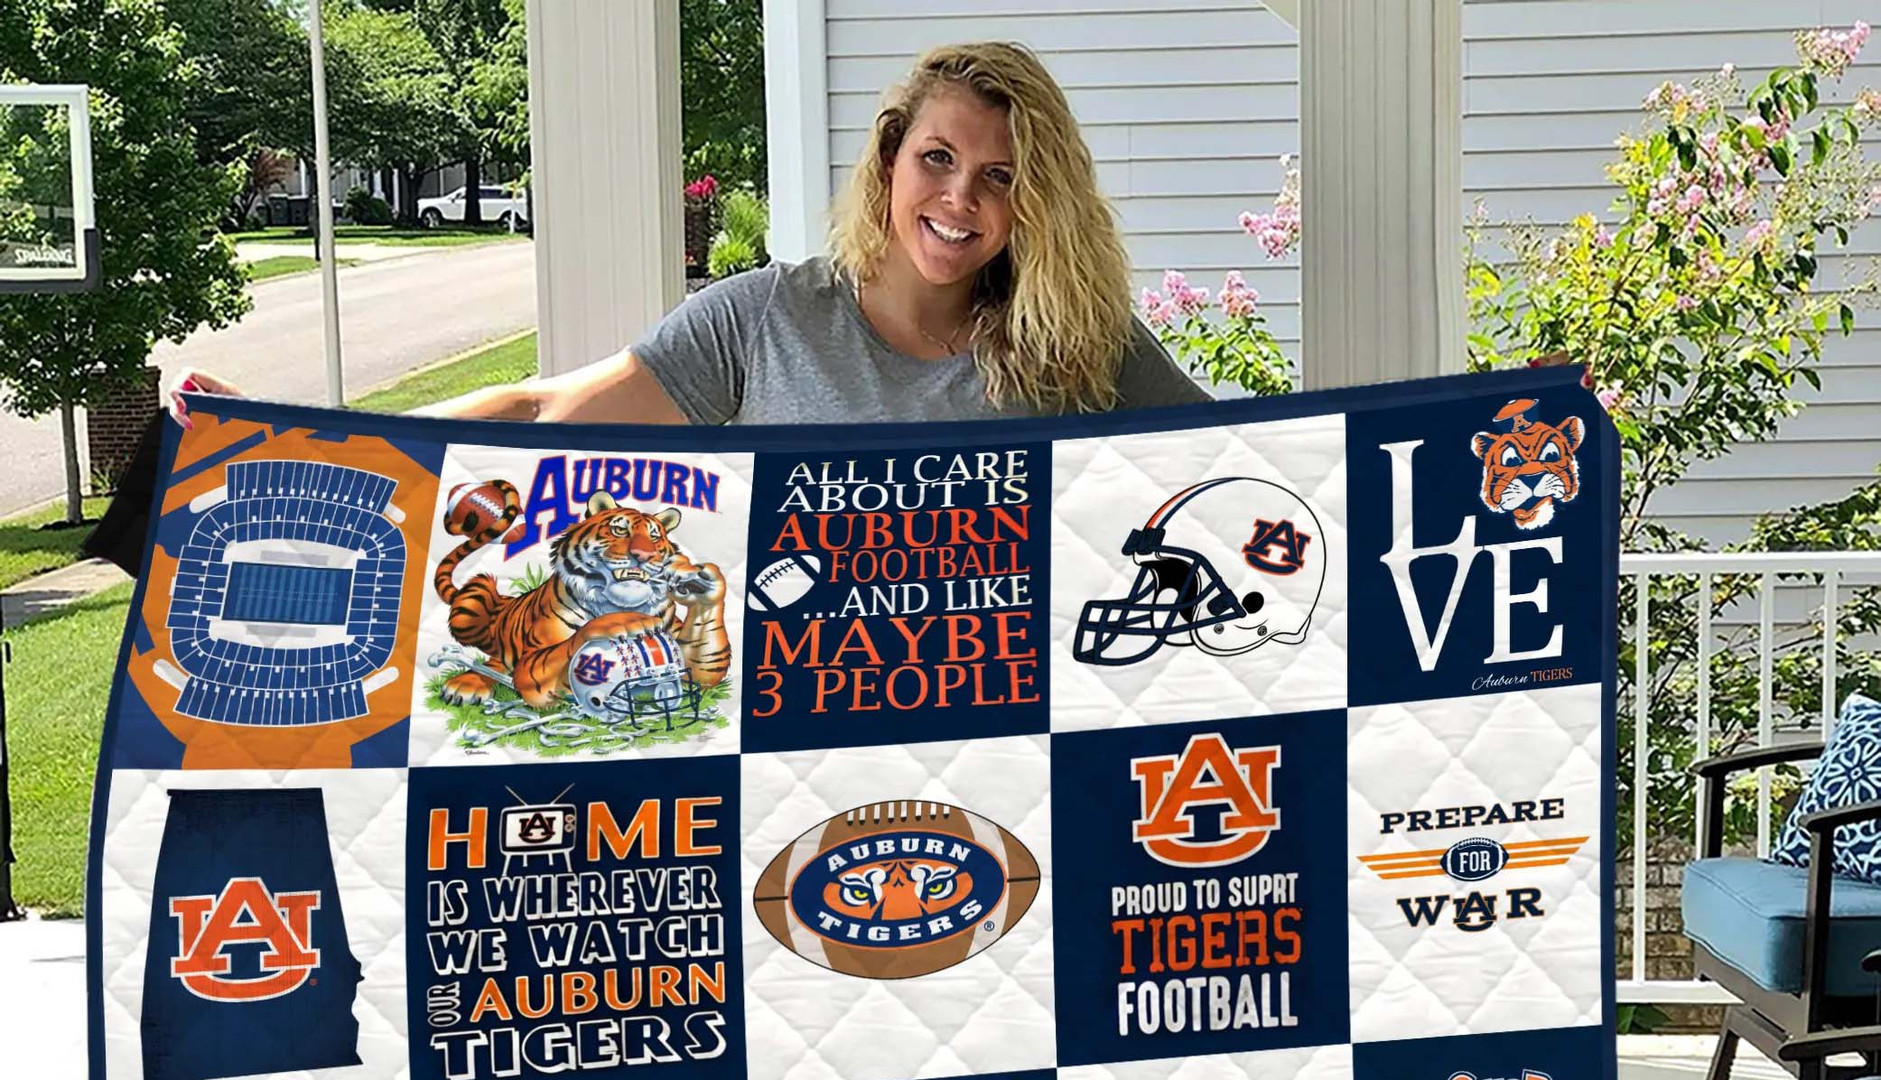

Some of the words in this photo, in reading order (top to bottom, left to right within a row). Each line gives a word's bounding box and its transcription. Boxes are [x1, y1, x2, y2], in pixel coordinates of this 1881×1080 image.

[786, 461, 868, 485] ALL
[884, 459, 896, 483] I
[914, 450, 1028, 483] CARE
[503, 455, 720, 562] AUBURN
[777, 481, 965, 512] ABOUT
[984, 478, 1029, 505] IS
[769, 505, 1032, 551] AUBURN
[829, 542, 1030, 582] FOOTBALL
[944, 575, 1033, 611] LIKE
[757, 612, 1037, 669] MAYBE
[752, 672, 783, 717] 3
[811, 660, 1040, 713] PEOPLE
[1472, 673, 1528, 691] Auburn
[1531, 667, 1573, 682] TIGERS
[1380, 798, 1564, 834] PREPARE
[827, 838, 971, 872] AUBURN
[1459, 851, 1492, 873] FOR
[427, 879, 469, 927] IS
[483, 866, 722, 922] WHEREVER
[1111, 881, 1187, 916] PROUD
[1192, 878, 1221, 910] TO
[1228, 872, 1299, 907] SUPRT
[817, 899, 983, 942] TIGERS
[1112, 908, 1301, 974] TIGERS
[427, 928, 508, 975] WE
[528, 914, 724, 968] WATCH
[427, 981, 461, 1028] OUR
[470, 961, 726, 1023] AUBURN
[1117, 971, 1298, 1036] FOOTBALL
